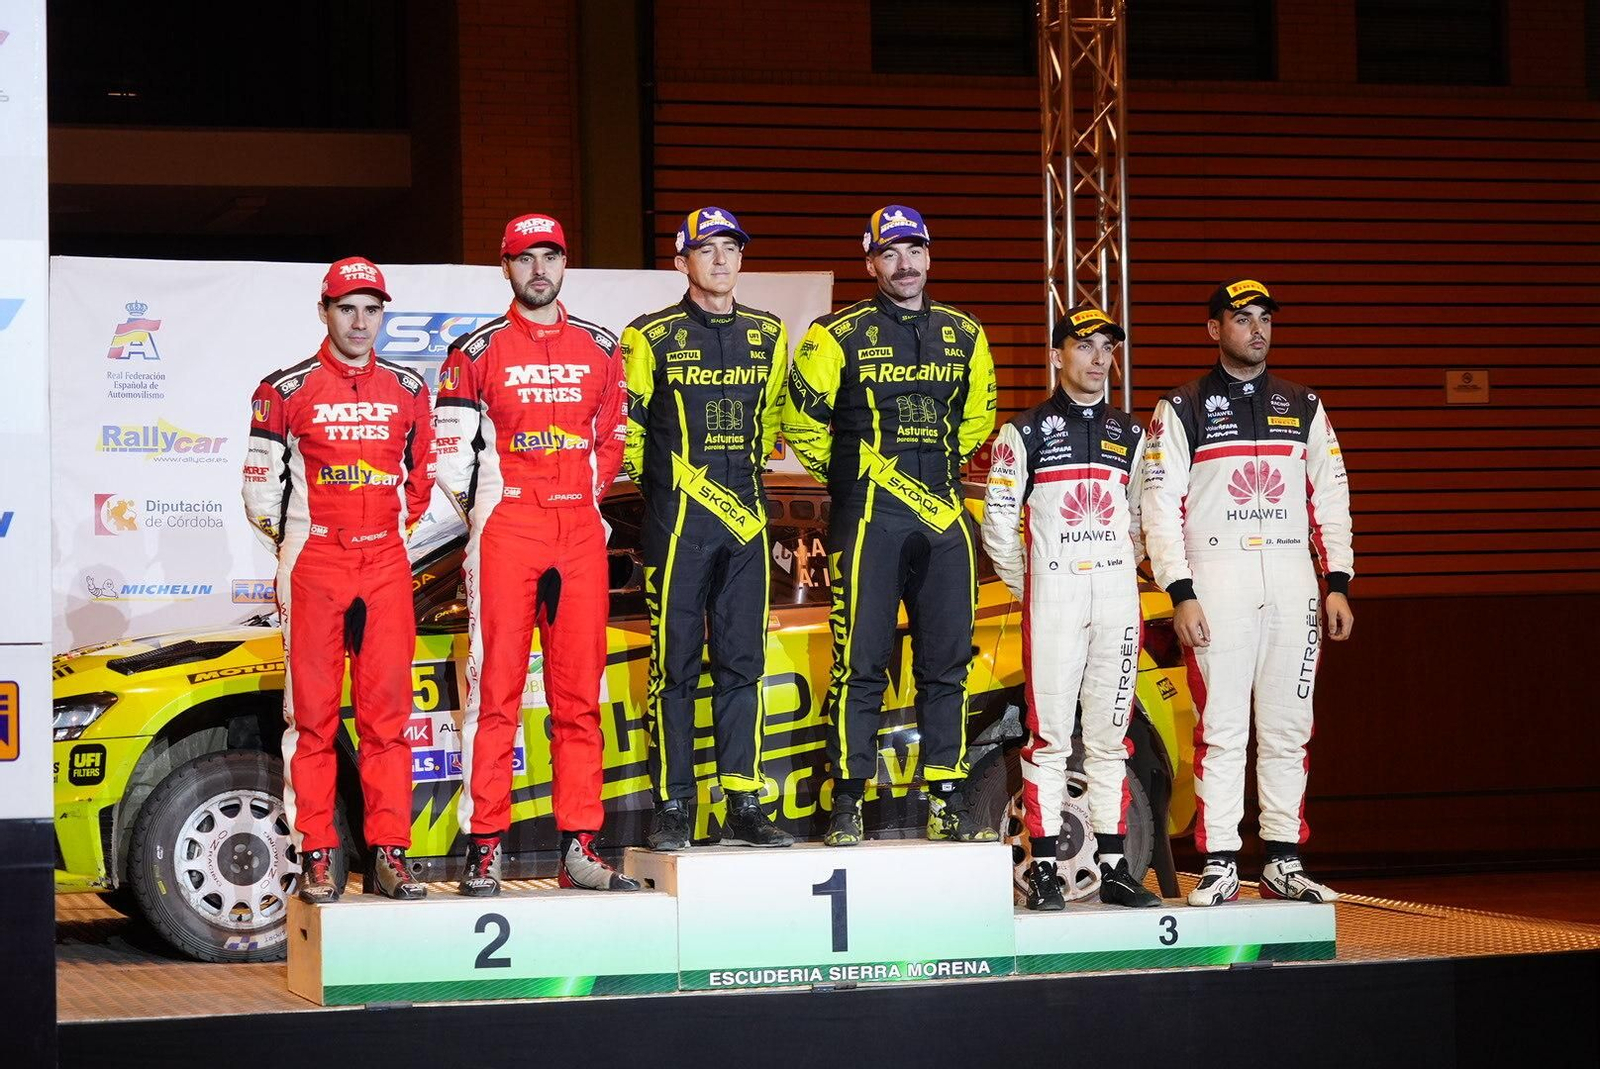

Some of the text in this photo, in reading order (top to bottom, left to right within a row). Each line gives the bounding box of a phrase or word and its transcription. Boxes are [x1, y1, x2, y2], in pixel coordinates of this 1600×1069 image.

[669, 352, 699, 361] MOTUL
[860, 348, 891, 358] MOTUL
[106, 371, 166, 381] Real Federación
[504, 364, 591, 387] MRF
[686, 365, 756, 385] Recalvi
[878, 362, 952, 383] Recalvi
[113, 380, 159, 391] Española de
[107, 390, 165, 399] Automovilismo
[517, 387, 583, 403] TYRES
[312, 401, 399, 424] MRF
[1207, 410, 1233, 418] HUAWEI
[324, 425, 390, 441] TYRES
[897, 425, 939, 437] Asturias
[704, 433, 745, 444] Asturias
[992, 467, 1016, 476] UAWEI
[146, 499, 223, 515] Diputación
[1226, 508, 1288, 521] HUAWEI
[145, 515, 224, 528] de Córdoba
[1060, 530, 1117, 543] HUAWEI
[1095, 561, 1105, 569] A.
[120, 584, 213, 595] MICHELIN
[74, 752, 101, 768] UFI
[73, 768, 100, 777] FILTERS
[812, 868, 849, 953] 1
[1159, 915, 1180, 946] 3
[474, 913, 512, 969] 2
[709, 960, 991, 986] ESCUDERIA SIERRA MORENA
